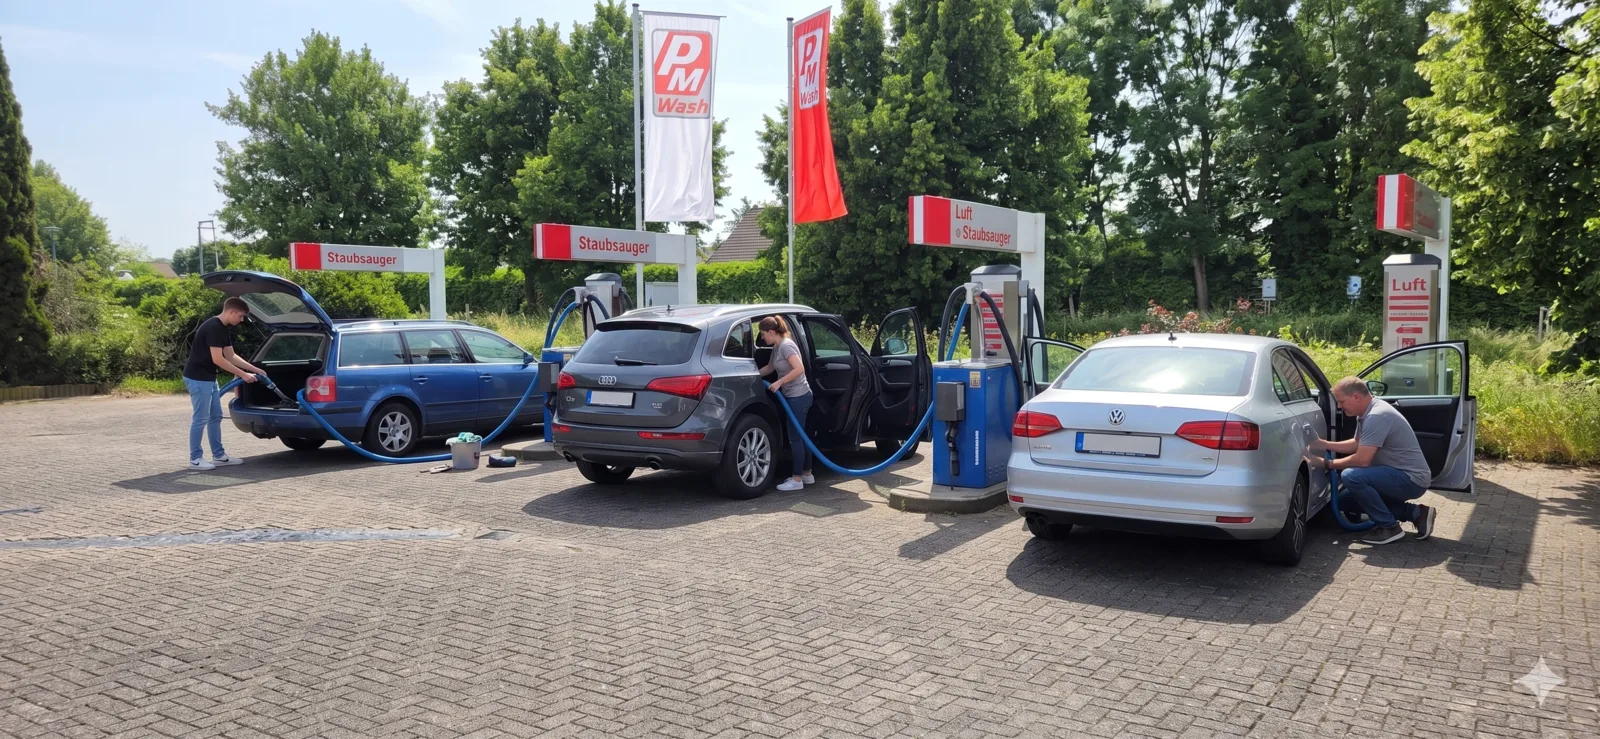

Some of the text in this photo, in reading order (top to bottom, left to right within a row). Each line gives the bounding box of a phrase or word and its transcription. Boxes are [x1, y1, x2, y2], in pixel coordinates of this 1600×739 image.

[801, 87, 819, 106] Wash
[657, 97, 709, 114] Wash
[955, 204, 973, 221] Luft
[963, 225, 1012, 247] Staubsauger
[578, 235, 650, 257] Staubsauger
[327, 251, 397, 268] Staubsauger
[1392, 277, 1427, 292] Luft
